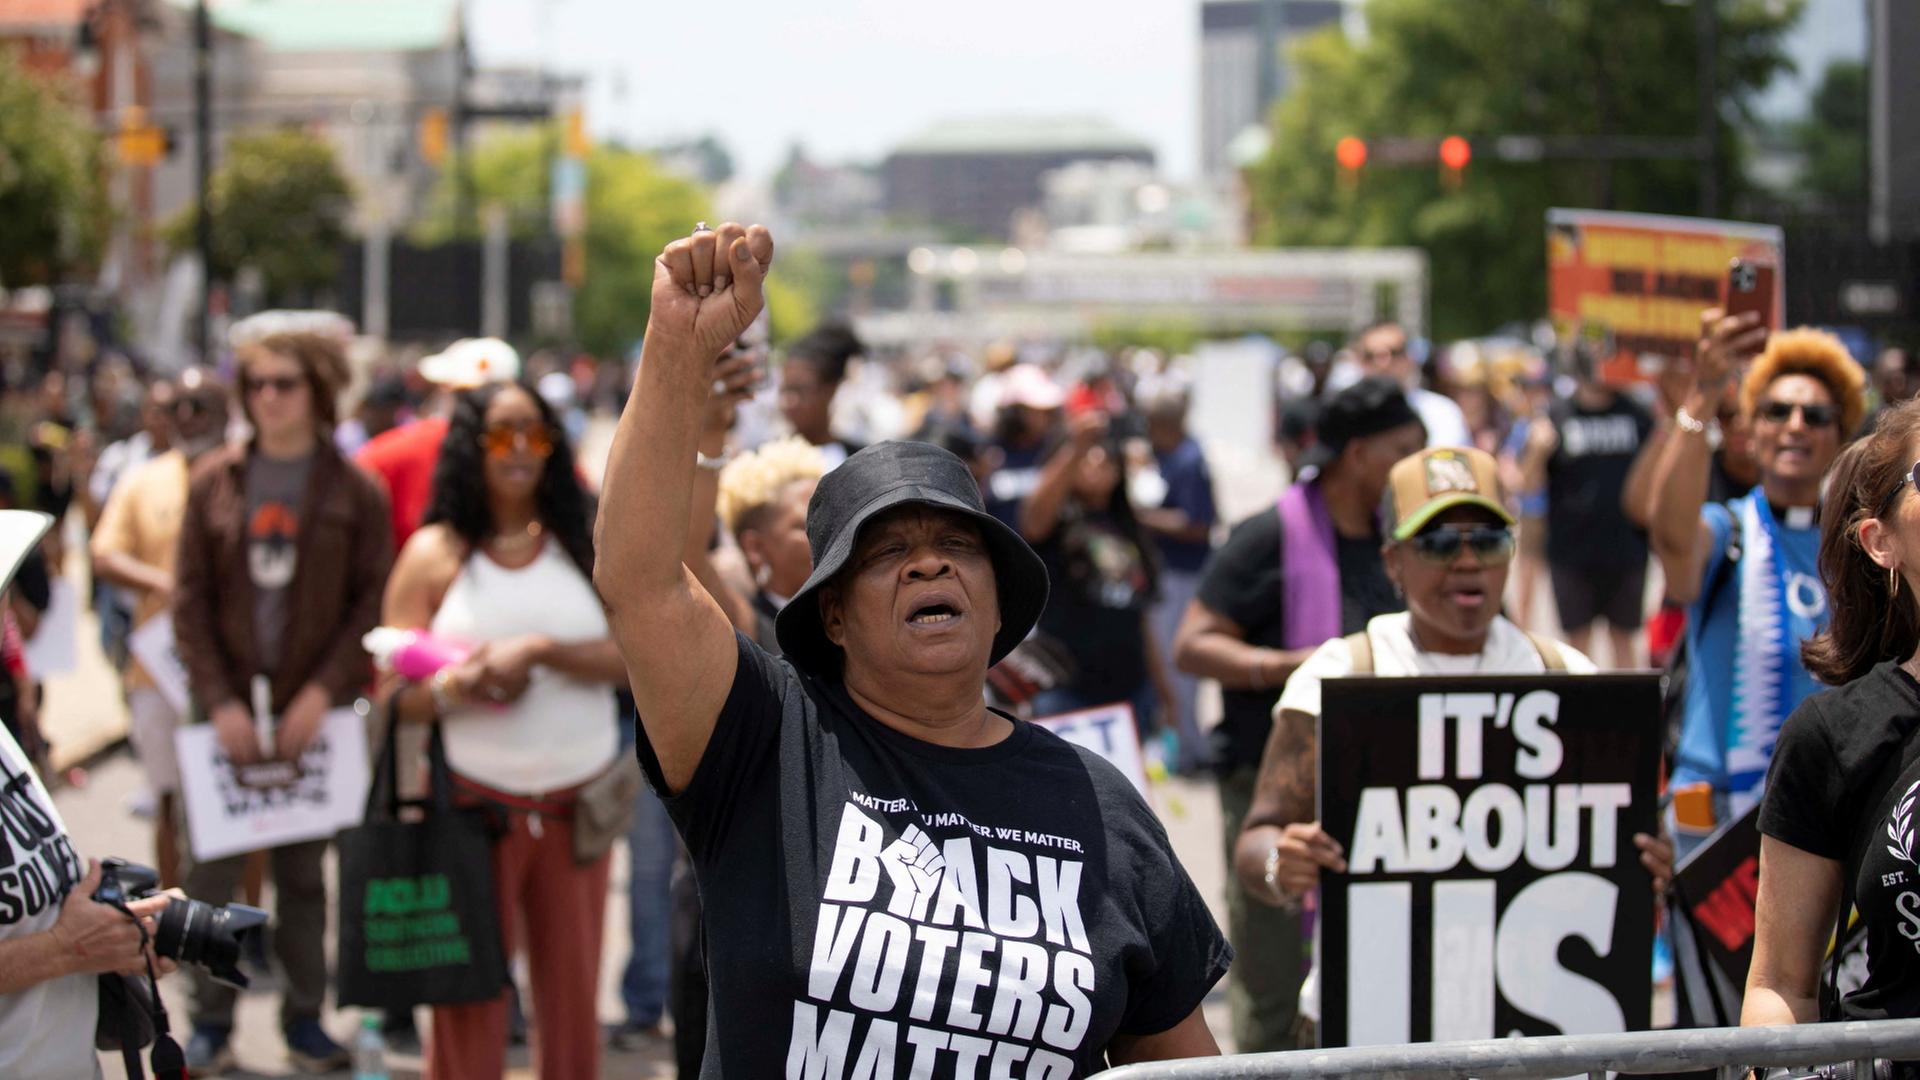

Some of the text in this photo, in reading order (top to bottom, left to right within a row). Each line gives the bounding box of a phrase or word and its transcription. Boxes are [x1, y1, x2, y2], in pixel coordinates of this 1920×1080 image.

[1418, 690, 1564, 780] IT'S
[852, 791, 910, 813] MATTER.
[996, 827, 1022, 842] WE
[1024, 831, 1084, 854] MATTER.
[1349, 782, 1632, 873] ABOUT
[1881, 870, 1910, 887] EST.
[808, 902, 1095, 1051] VOTERS
[1347, 871, 1626, 1080] US
